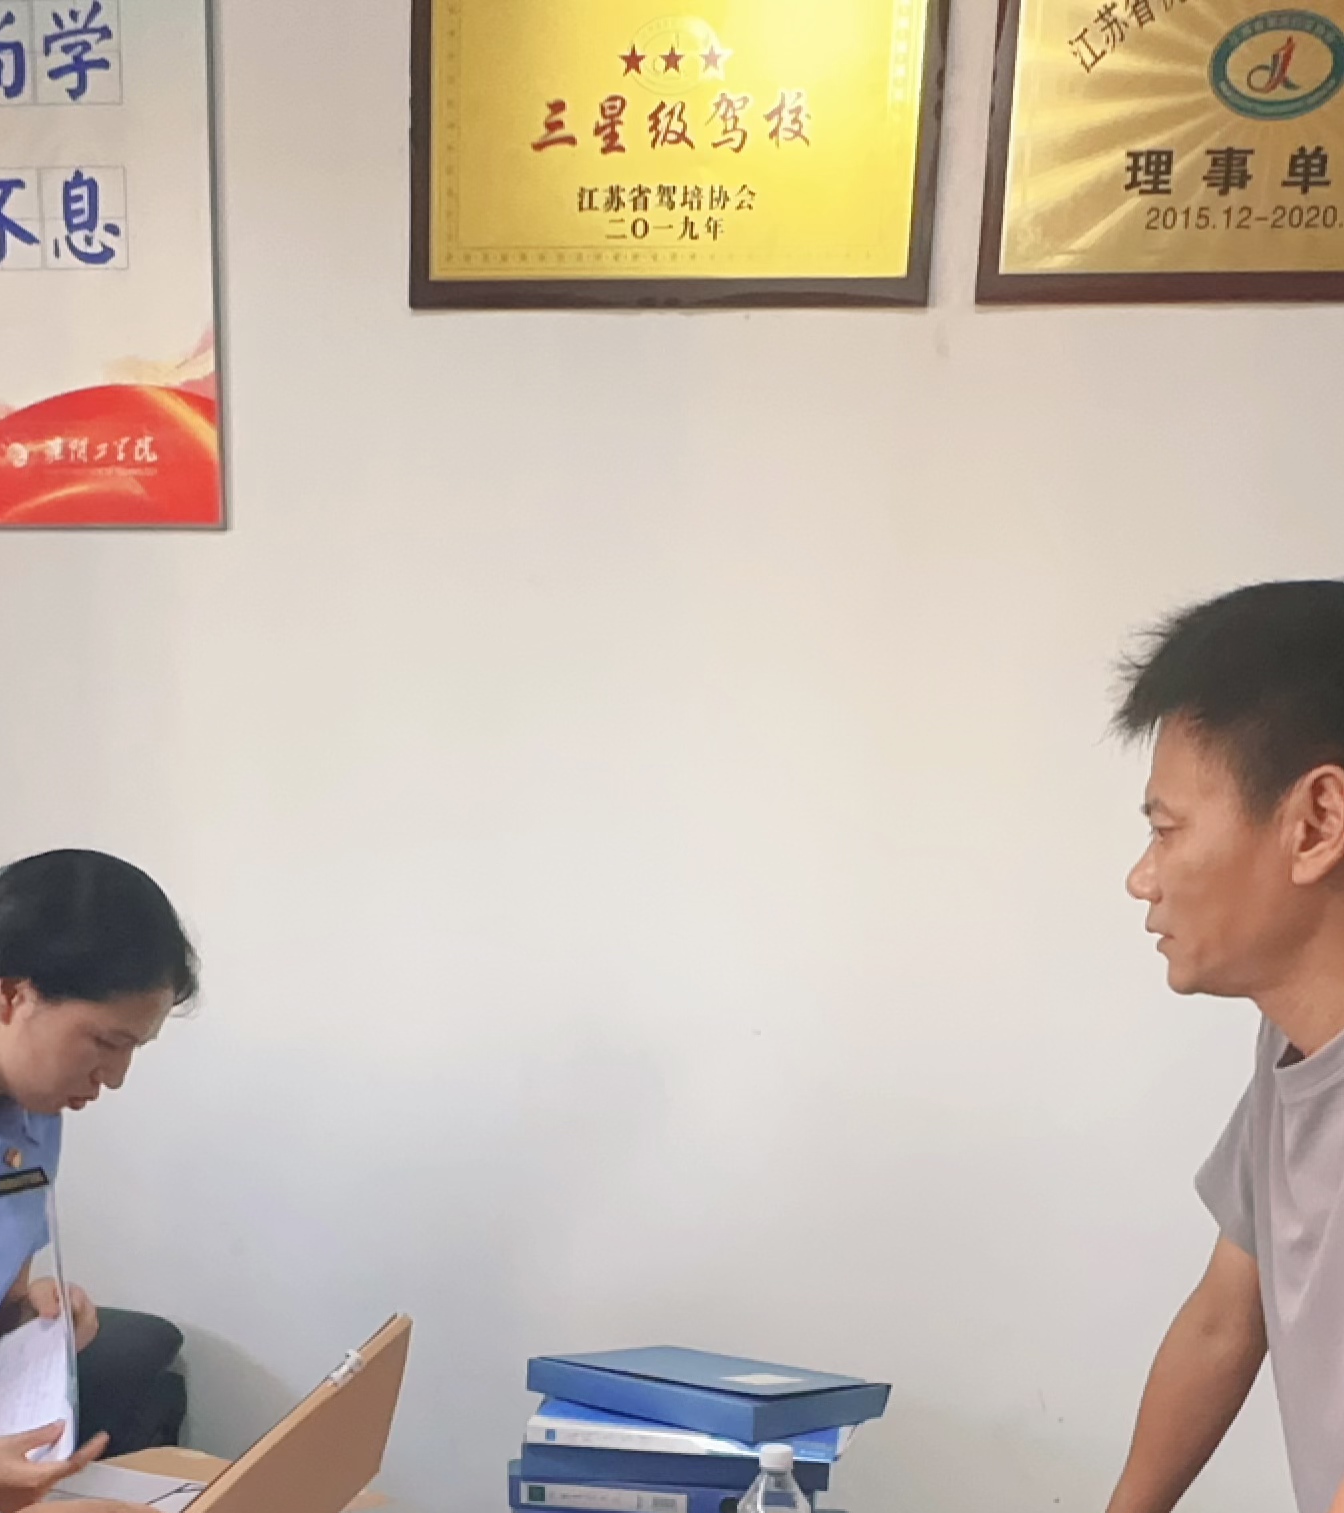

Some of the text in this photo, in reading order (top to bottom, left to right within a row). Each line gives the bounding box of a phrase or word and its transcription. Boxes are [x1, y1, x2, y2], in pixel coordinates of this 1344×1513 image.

[530, 92, 813, 155] 三星级驾校
[576, 183, 758, 213] 江苏省驾培协会
